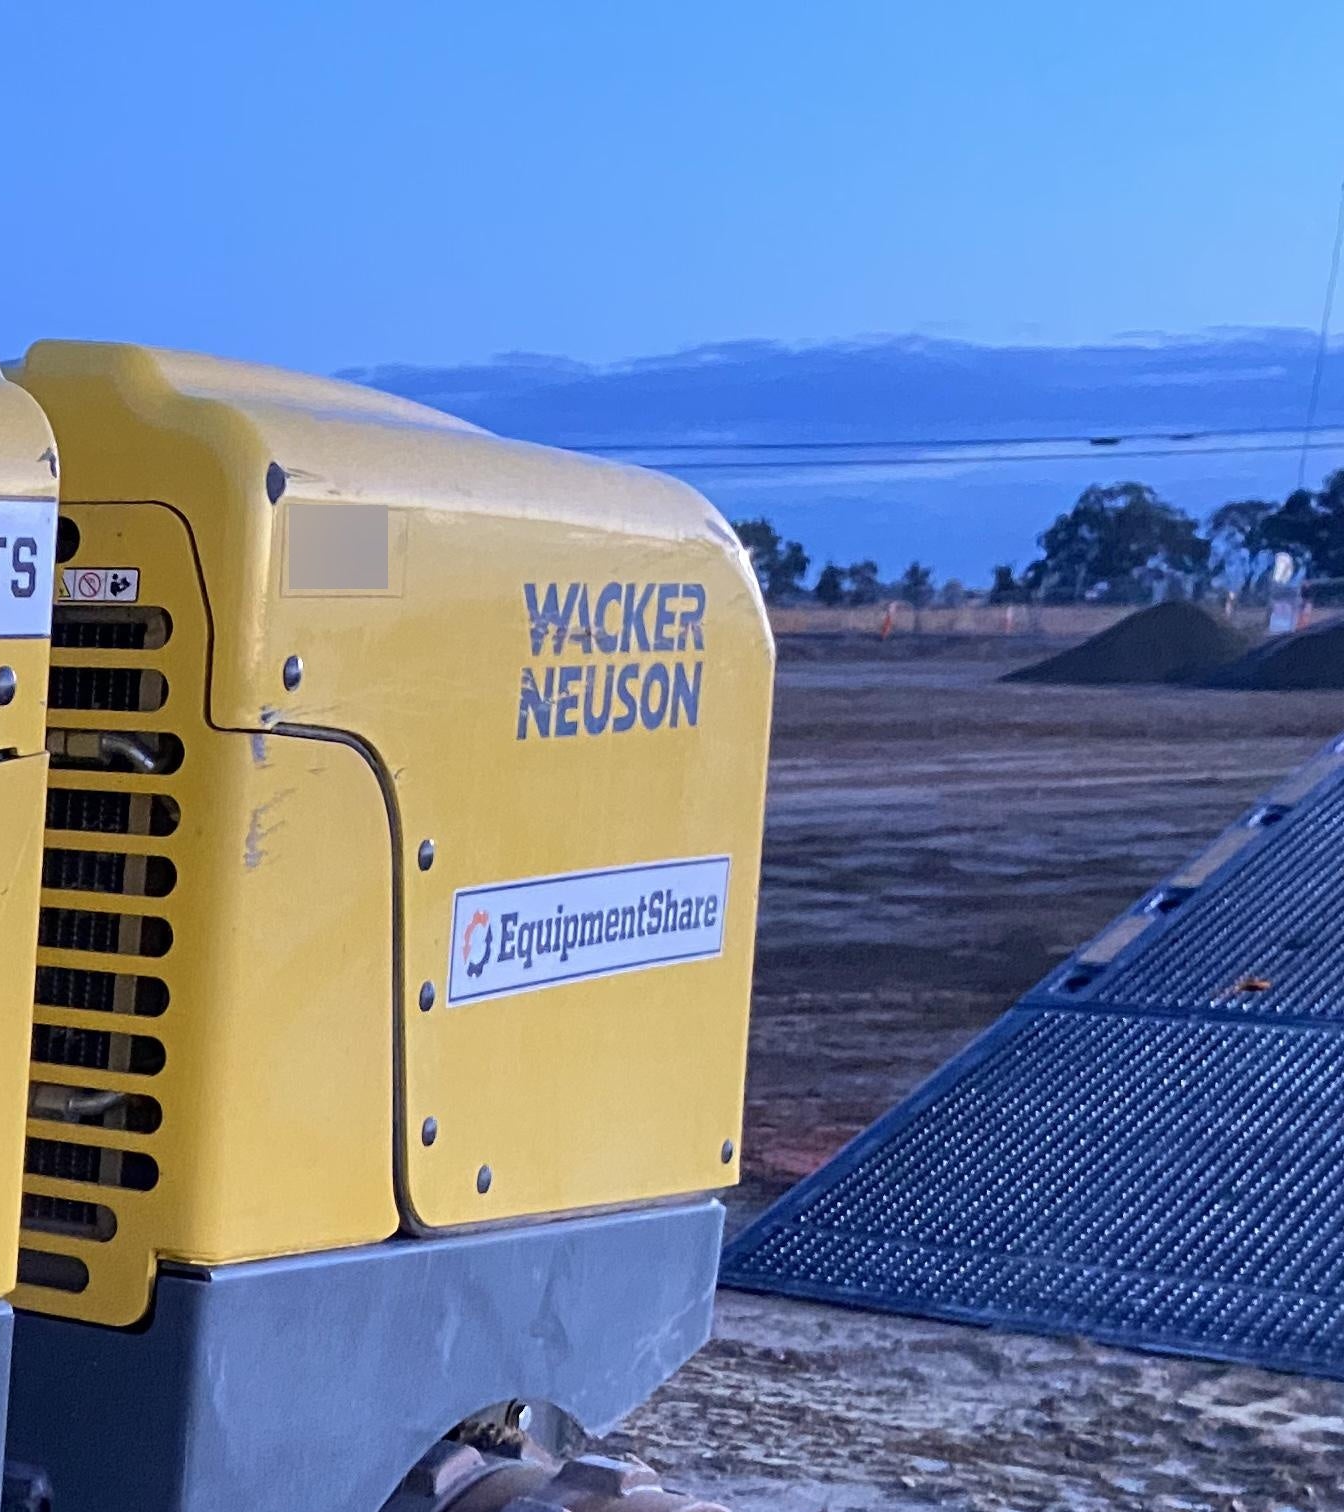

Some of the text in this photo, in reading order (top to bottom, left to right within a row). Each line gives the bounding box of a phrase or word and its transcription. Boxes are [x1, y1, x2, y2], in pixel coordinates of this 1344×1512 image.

[524, 581, 707, 656] WACKER
[516, 661, 703, 740] NEUSON
[497, 889, 717, 968] EquipmentShare
